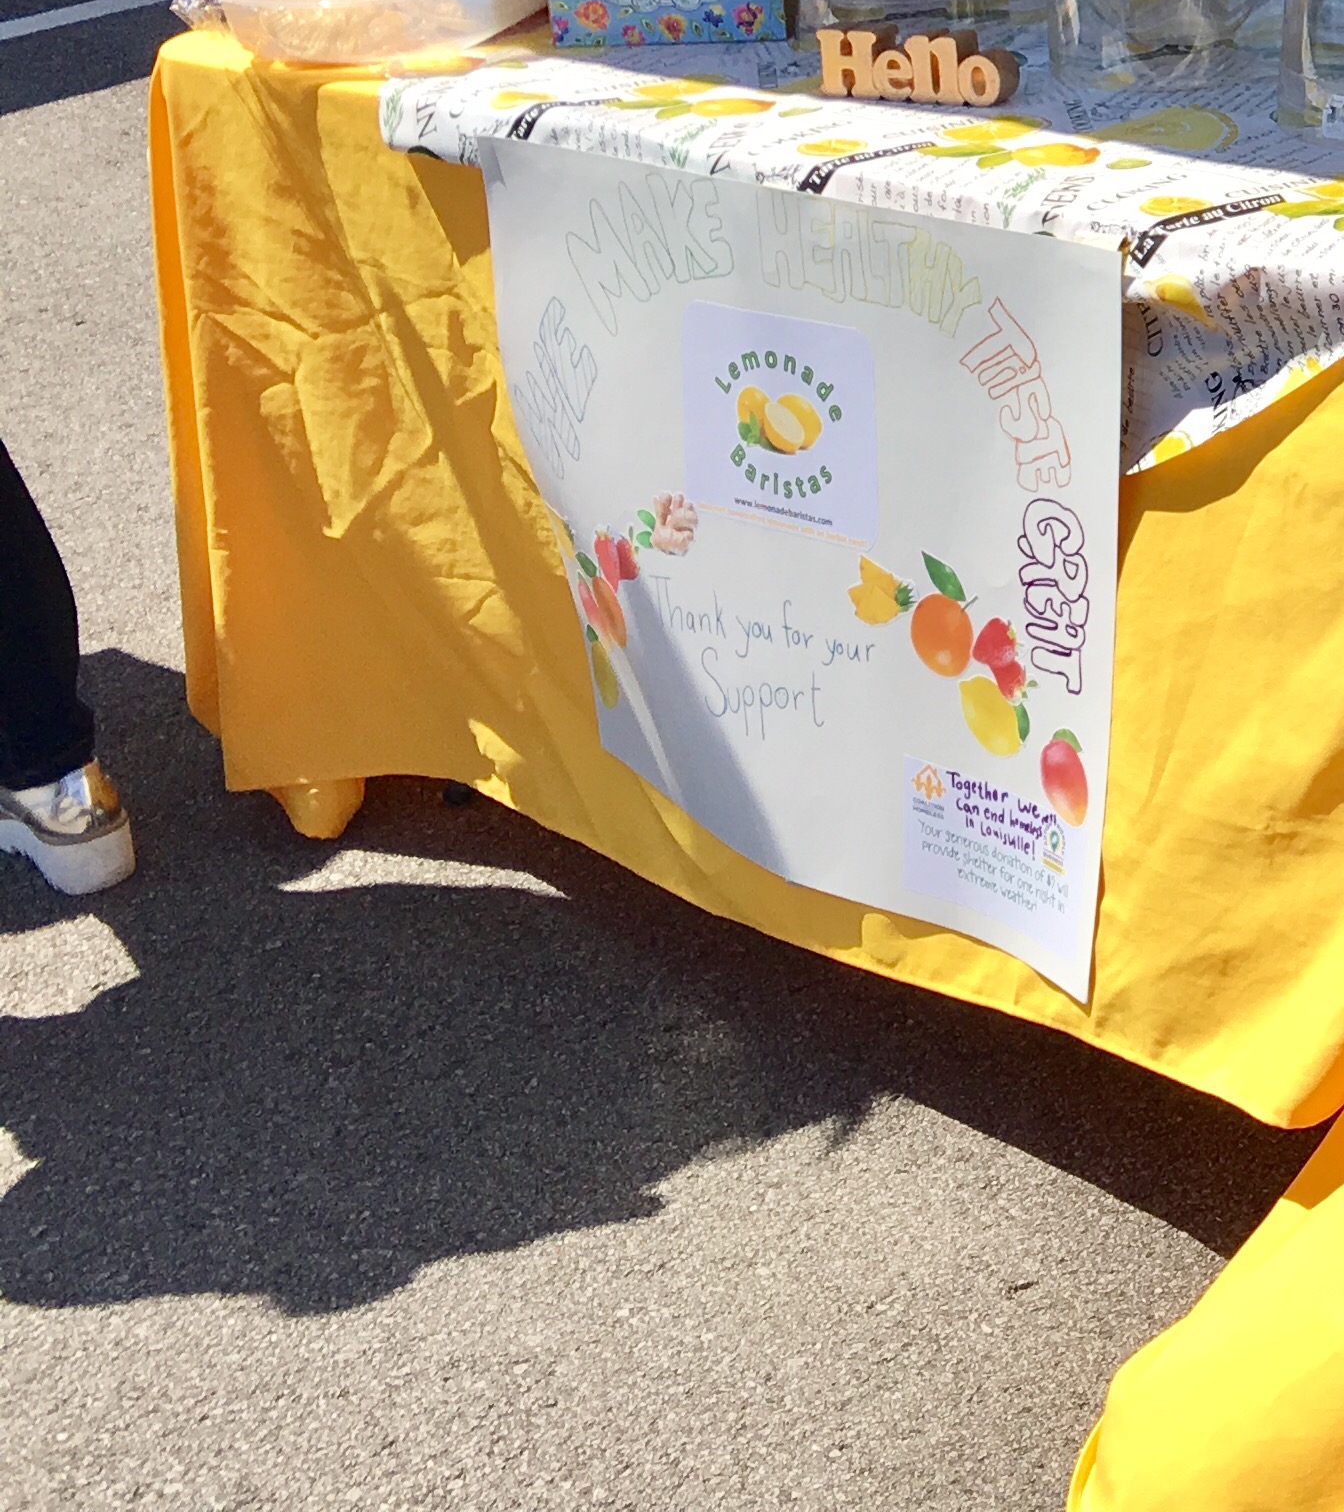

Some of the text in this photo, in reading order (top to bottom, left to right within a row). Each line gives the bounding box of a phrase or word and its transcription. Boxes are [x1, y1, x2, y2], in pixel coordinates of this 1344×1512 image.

[816, 29, 1001, 107] Hello
[1134, 236, 1155, 260] La
[1203, 207, 1225, 222] au
[1226, 194, 1283, 214] Citron
[715, 350, 842, 422] Lemonade
[514, 296, 598, 480] WE
[565, 173, 735, 337] MAKE
[756, 190, 983, 338] HEALTHY
[1017, 498, 1090, 695] GREAT
[730, 444, 832, 499] Baristas
[734, 496, 834, 527] www.lemonadebaristas.com
[649, 574, 876, 667] Thank you for your
[701, 646, 825, 741] Support
[946, 770, 1009, 803] Together
[984, 807, 1005, 824] end
[917, 819, 943, 839] Your
[944, 830, 990, 858] generous
[991, 846, 1033, 878] donation
[1034, 867, 1046, 882] of
[922, 840, 961, 862] provide
[962, 852, 998, 875] shelter
[999, 865, 1016, 884] for
[980, 824, 1036, 861] Louisville!
[957, 867, 999, 894] extreme
